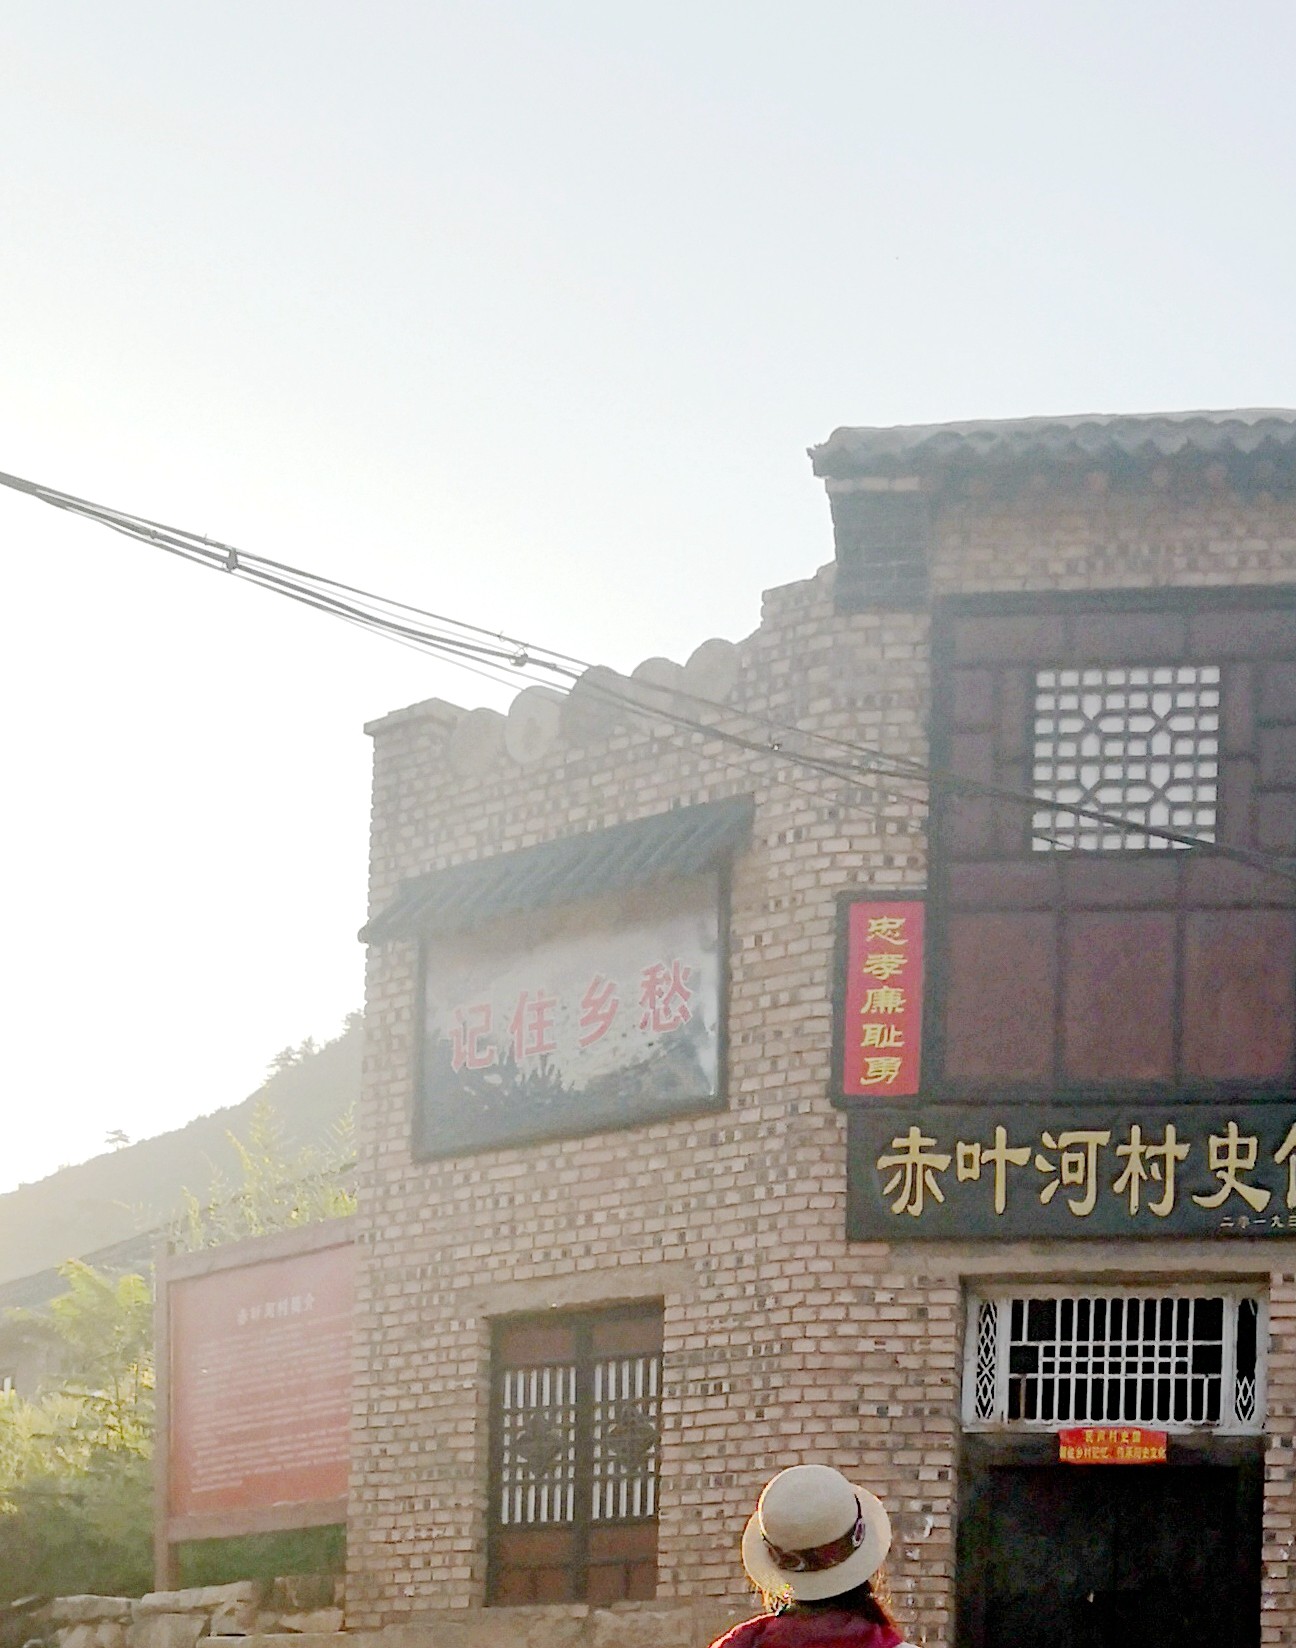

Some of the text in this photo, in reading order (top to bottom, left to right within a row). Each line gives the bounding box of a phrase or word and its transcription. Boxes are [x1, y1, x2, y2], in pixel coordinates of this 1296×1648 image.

[450, 958, 693, 1072] 记住乡愁
[860, 916, 908, 1086] 忠孝廉耻勇
